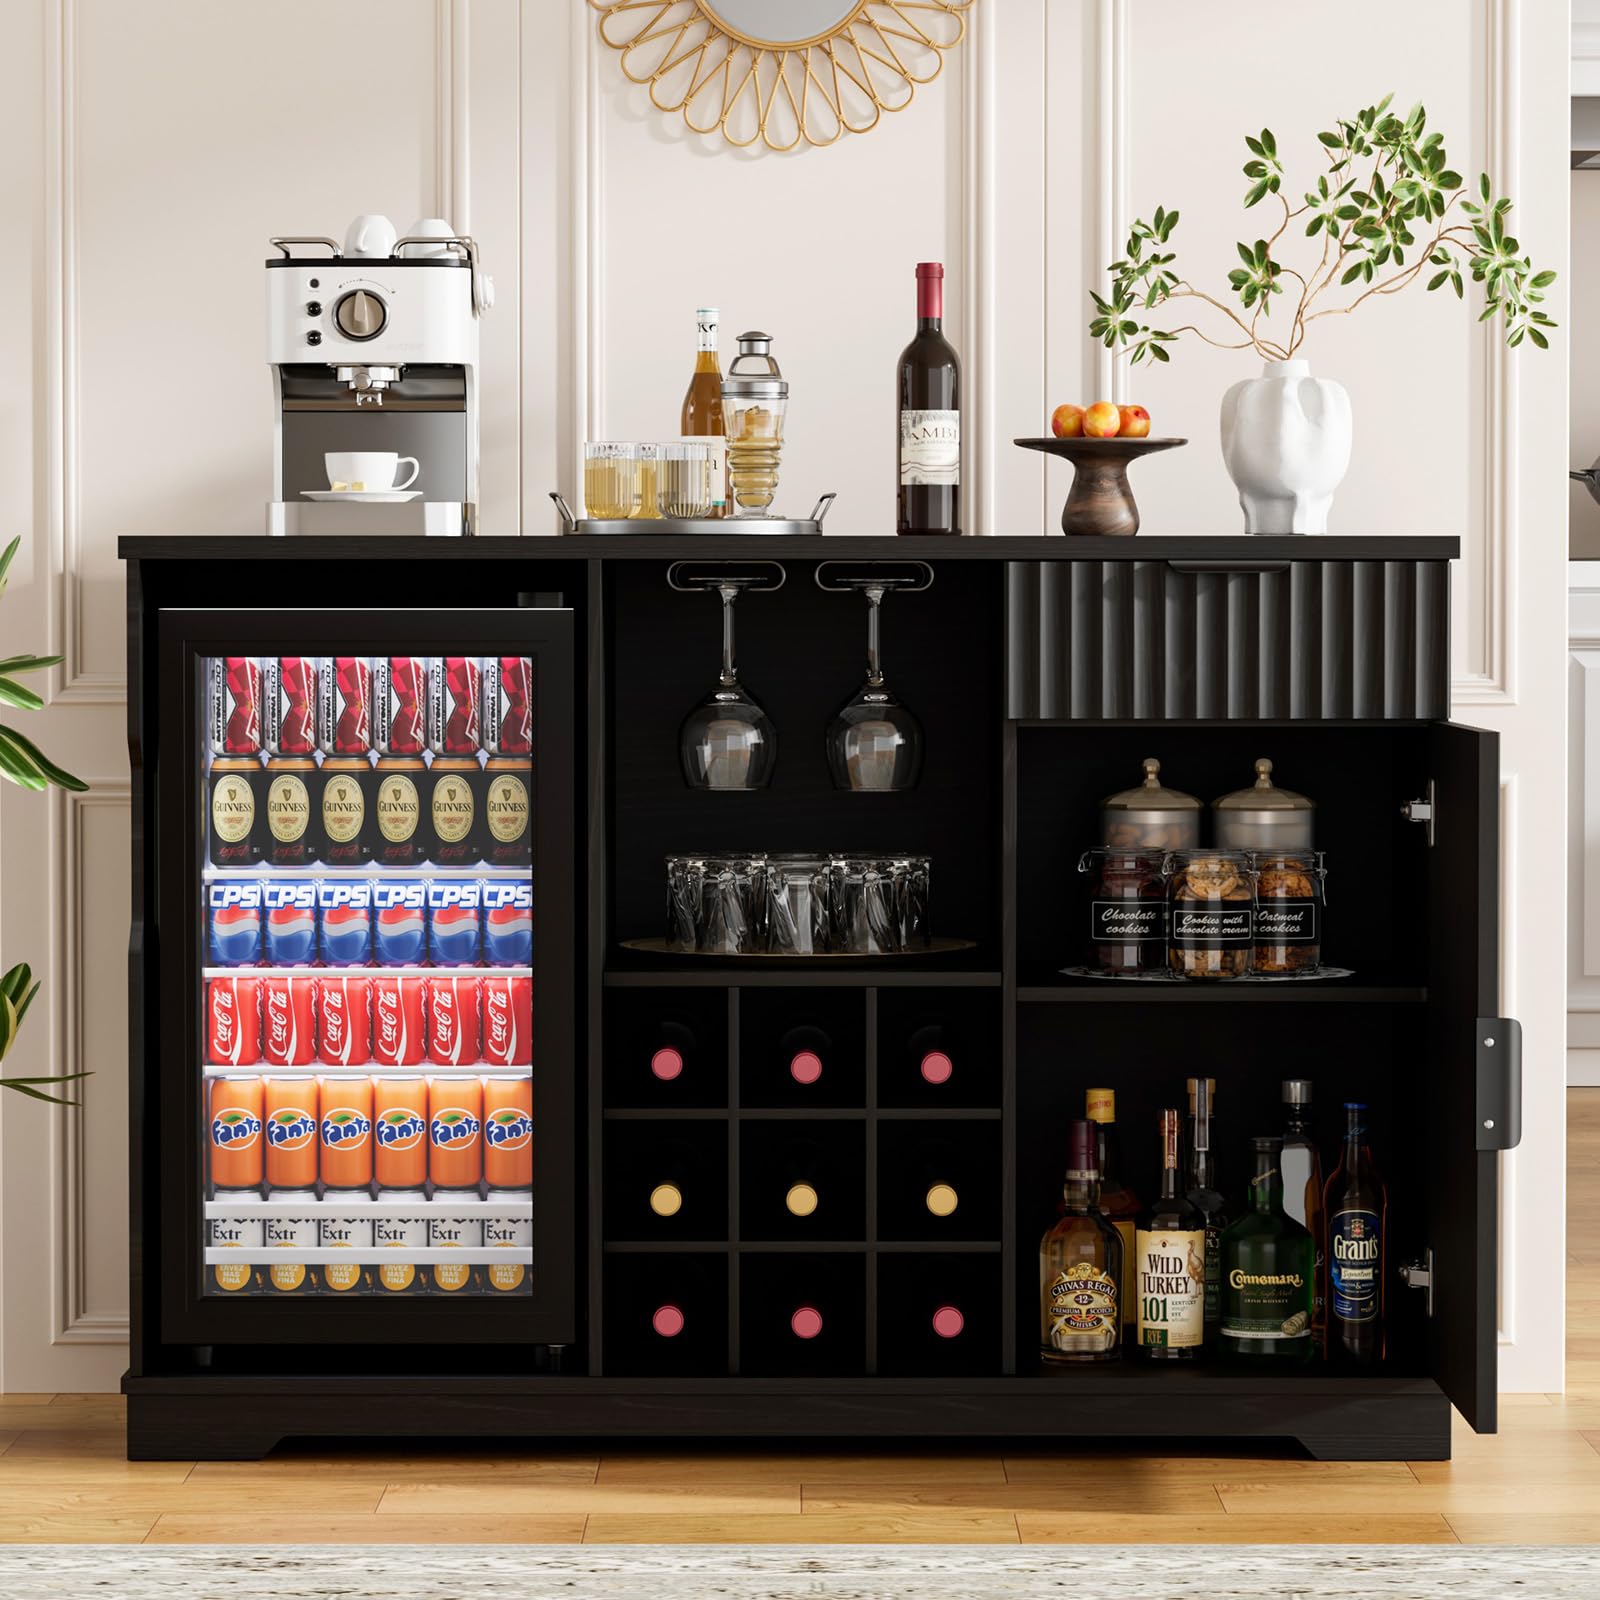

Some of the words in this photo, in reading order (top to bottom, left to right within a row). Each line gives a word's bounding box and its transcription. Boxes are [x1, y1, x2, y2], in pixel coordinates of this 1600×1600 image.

[214, 801, 252, 813] GUINNESS
[269, 801, 307, 813] GUINNESS
[324, 801, 361, 813] GUINNESS
[379, 801, 416, 813] GUINNESS
[433, 801, 471, 813] GUINNESS
[488, 801, 526, 813] GUINNESS
[1101, 908, 1156, 921] Chocolate
[1182, 914, 1219, 925] Cookies
[1223, 915, 1243, 924] with
[1258, 911, 1304, 921] Oatmeal
[1106, 922, 1150, 933] cookies
[1176, 925, 1219, 934] chocolate
[1260, 922, 1301, 933] cookies
[212, 1117, 261, 1146] Fanta
[267, 1117, 316, 1146] Fanta
[322, 1117, 371, 1146] Fanta
[376, 1117, 425, 1146] Fanta
[431, 1117, 480, 1146] Fanta
[213, 1224, 242, 1240] Extr
[268, 1224, 297, 1240] Extr
[322, 1224, 351, 1240] Extr
[377, 1224, 406, 1240] Extr
[432, 1224, 461, 1240] Extr
[486, 1224, 516, 1240] Extr
[1334, 1234, 1378, 1260] Grant's
[1148, 1254, 1183, 1274] WILD
[1052, 1282, 1085, 1296] CHIVAS
[1087, 1281, 1115, 1297] REGAL
[1141, 1272, 1191, 1295] TURKEY
[1079, 1295, 1088, 1304] 12
[1053, 1307, 1080, 1315] PREMIUM
[1142, 1296, 1168, 1322] 101
[1069, 1319, 1099, 1328] WHISKY
[1147, 1330, 1162, 1344] RYE
